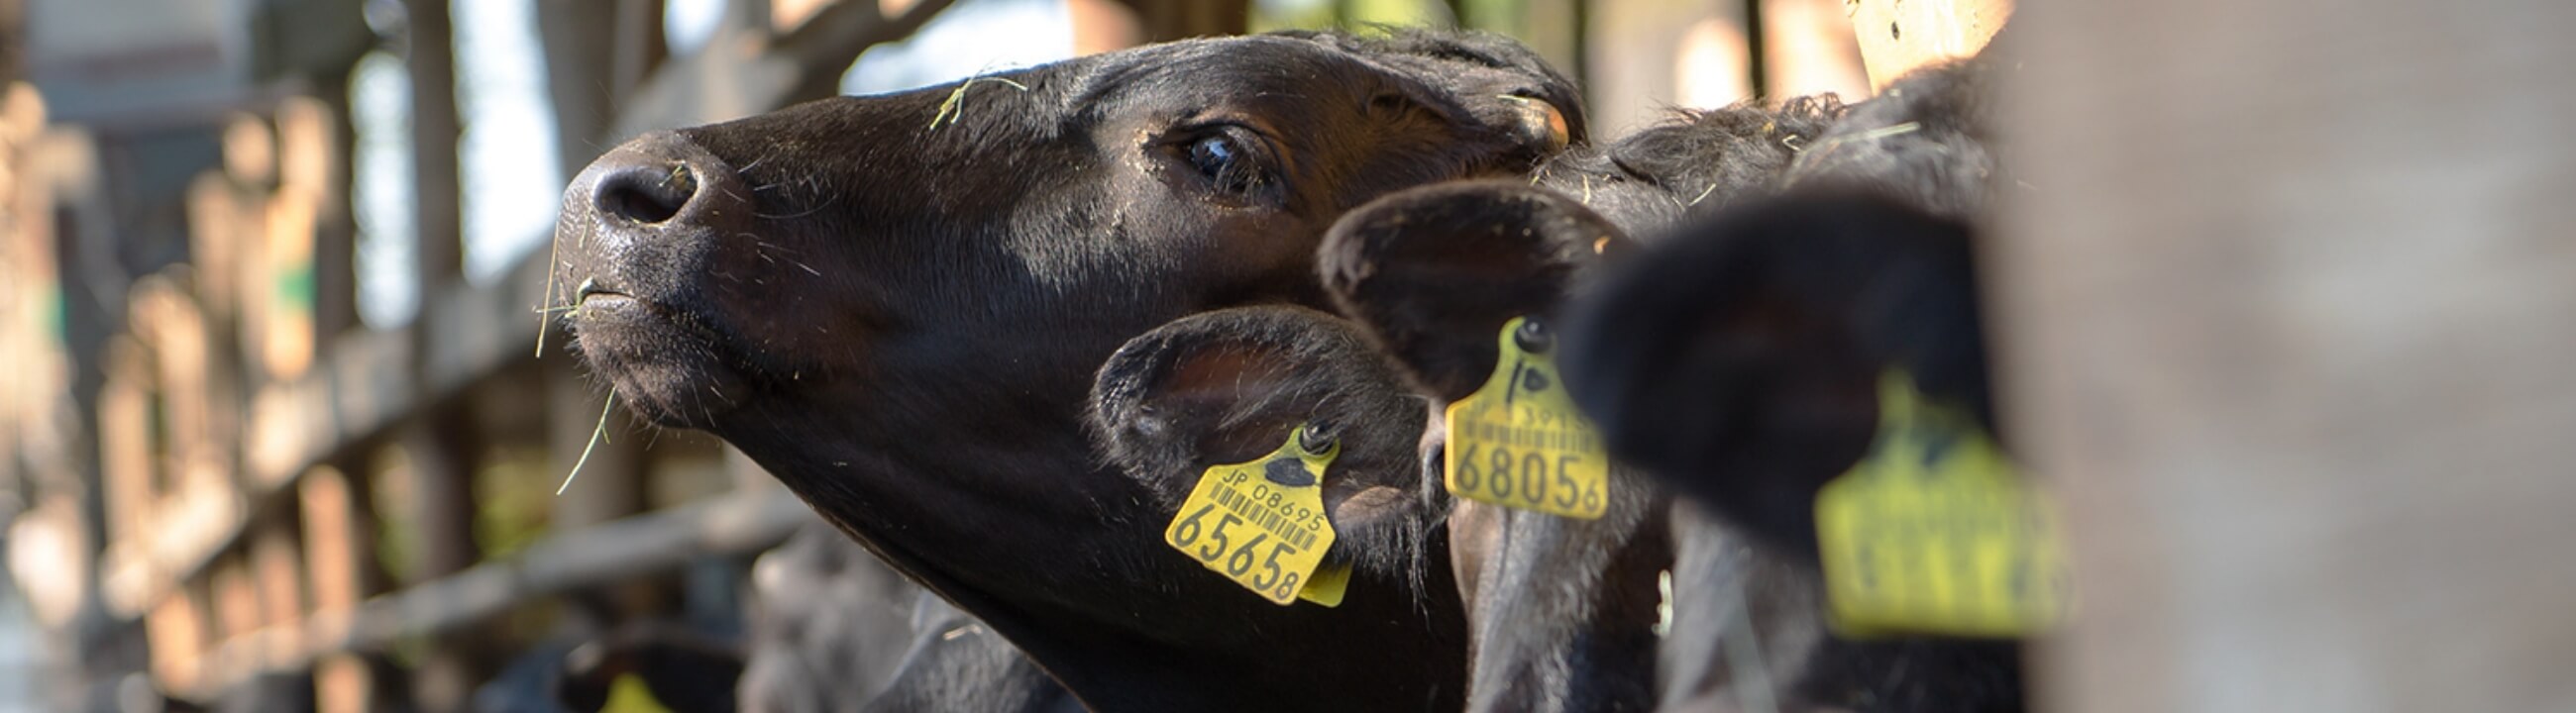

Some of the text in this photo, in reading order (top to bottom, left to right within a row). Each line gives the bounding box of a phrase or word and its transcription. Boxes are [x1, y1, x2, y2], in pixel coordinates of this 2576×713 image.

[1223, 468, 1325, 531] JP 08695
[1457, 444, 1599, 512] 68056
[1174, 503, 1300, 600] 65658
